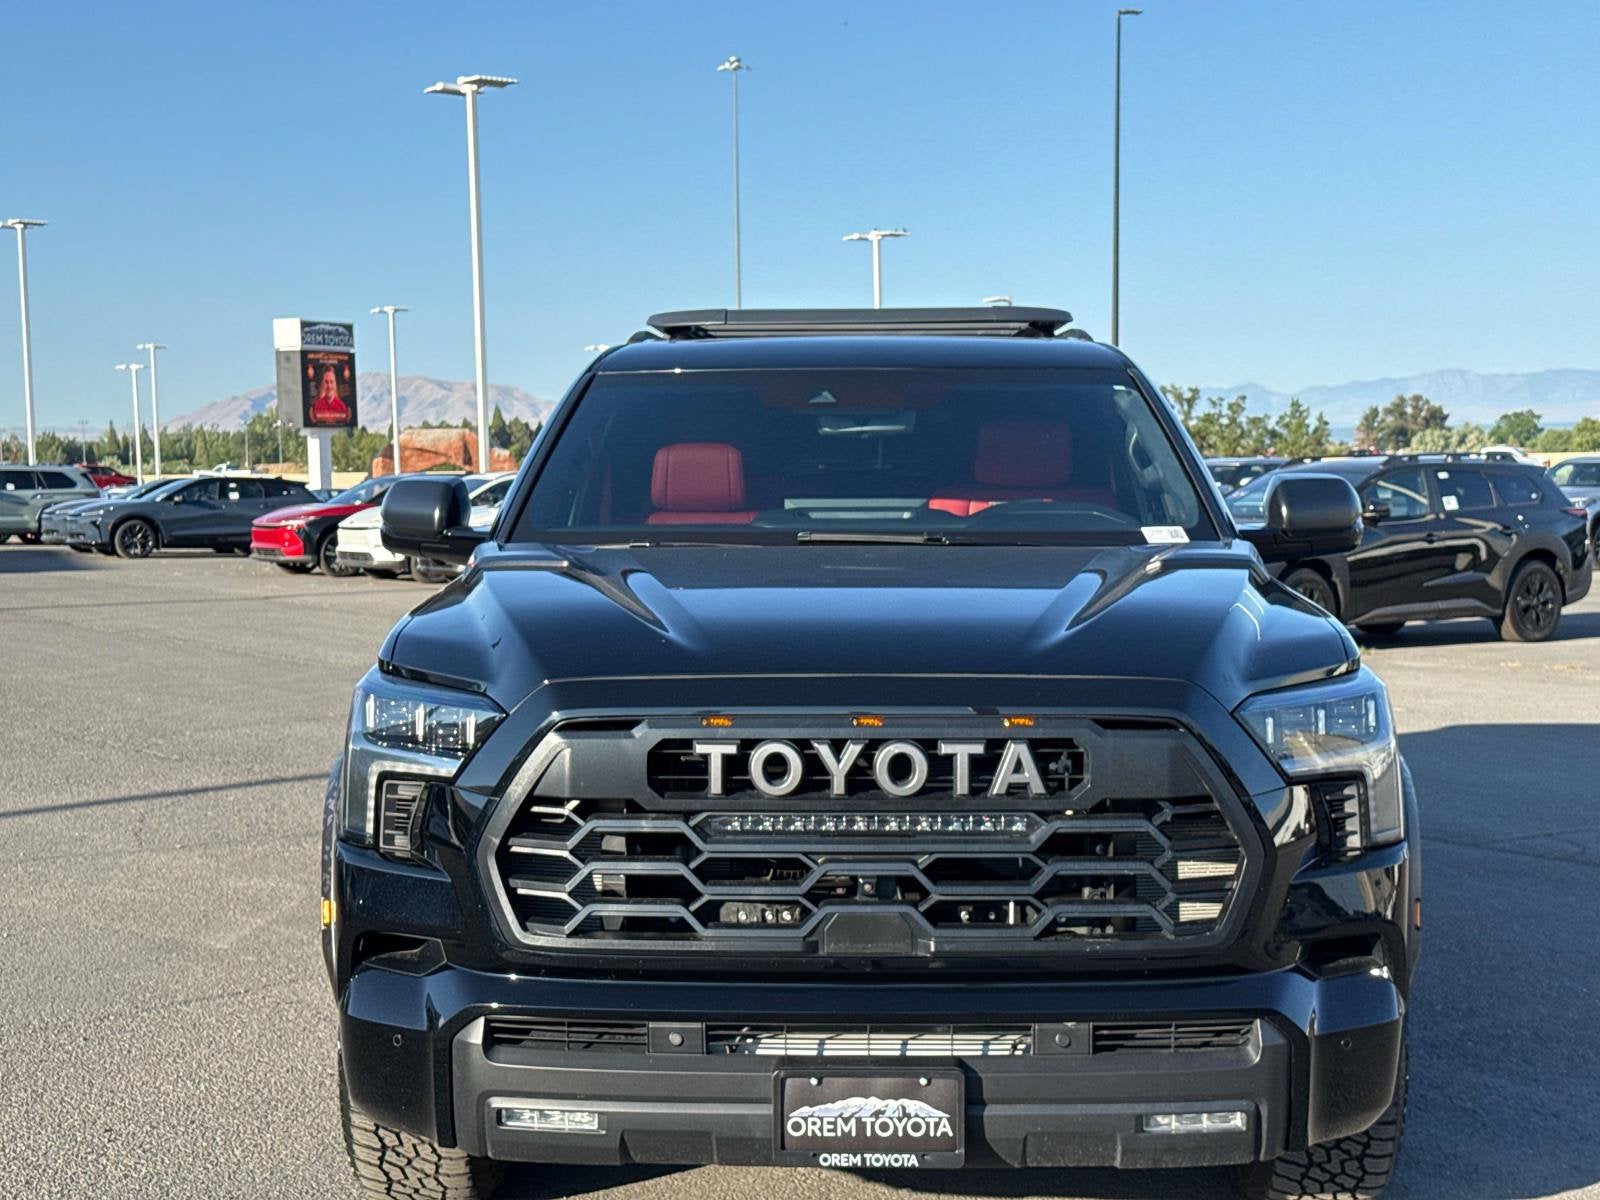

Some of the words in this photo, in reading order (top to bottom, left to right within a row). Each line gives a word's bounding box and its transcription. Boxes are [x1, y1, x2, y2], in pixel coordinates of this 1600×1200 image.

[324, 334, 352, 345] TOYOTA
[693, 739, 1047, 797] TOYOTA
[786, 1117, 856, 1137] OREM
[861, 1117, 953, 1137] TOYOTA
[819, 1153, 862, 1167] OREM
[863, 1153, 919, 1167] TOYOTA
